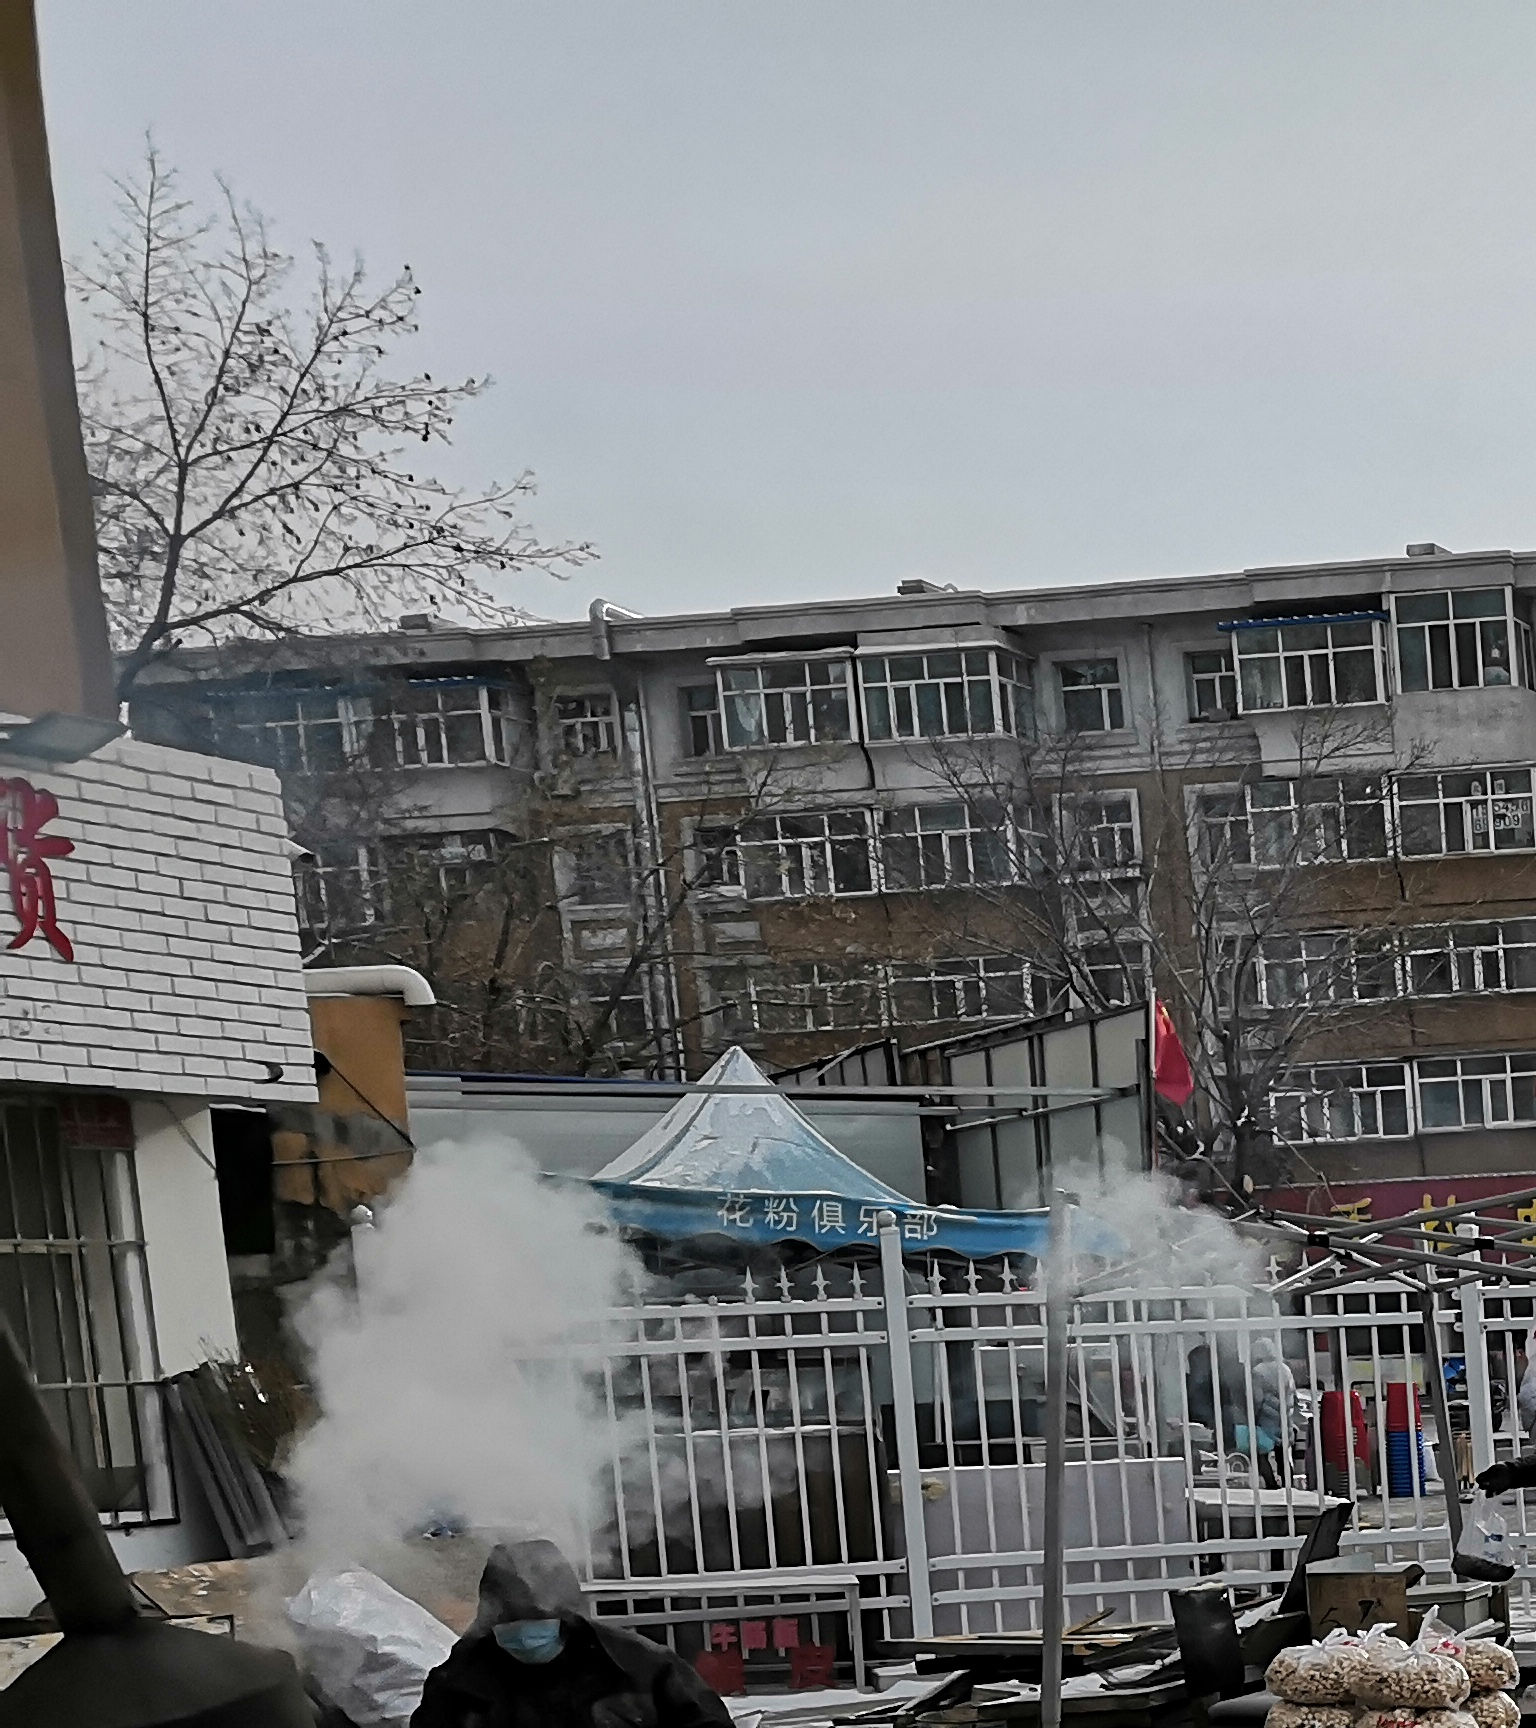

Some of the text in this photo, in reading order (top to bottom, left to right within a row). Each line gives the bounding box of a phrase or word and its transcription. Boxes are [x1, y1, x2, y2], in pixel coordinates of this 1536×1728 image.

[717, 1193, 938, 1241] 花粉俱乐部
